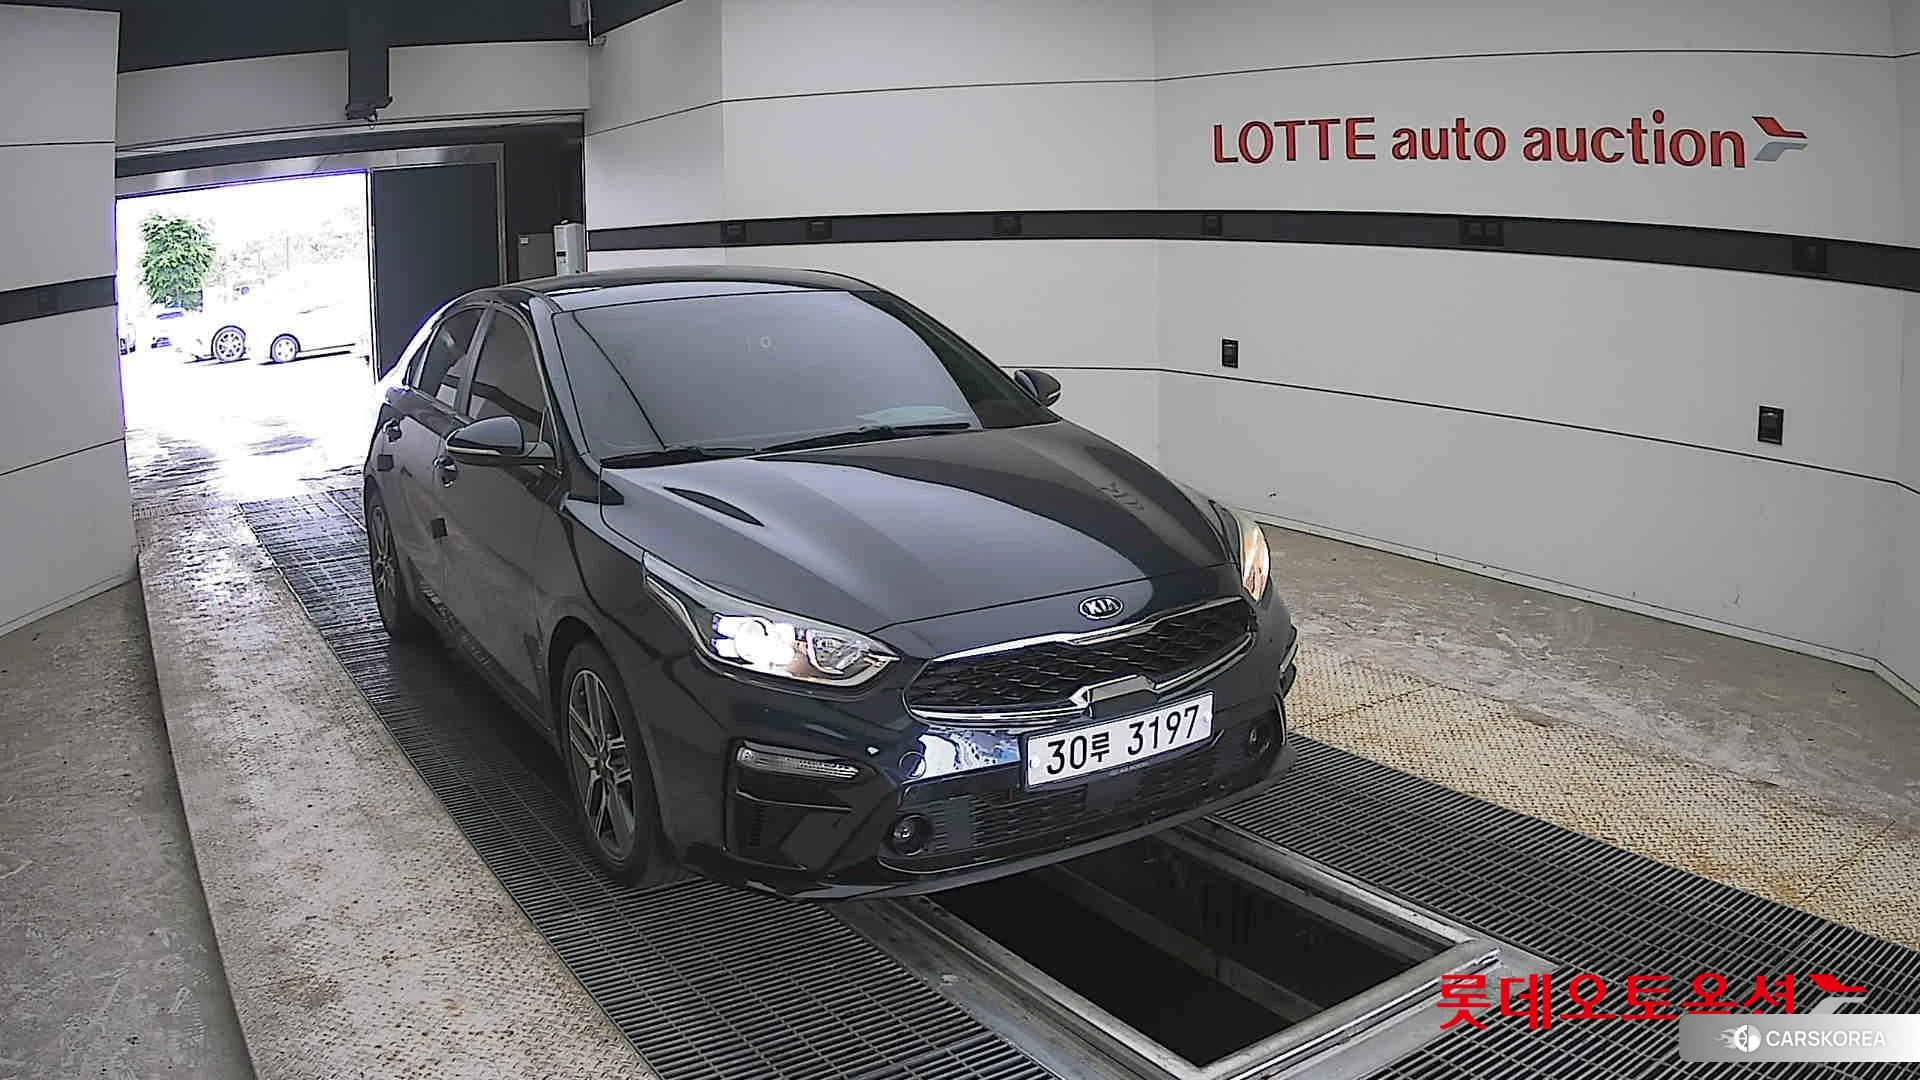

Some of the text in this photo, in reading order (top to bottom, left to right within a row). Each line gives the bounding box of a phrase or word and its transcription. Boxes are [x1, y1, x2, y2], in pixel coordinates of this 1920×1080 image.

[1213, 109, 1747, 169] LOTTE auto auction
[1085, 598, 1120, 615] KIA
[1046, 704, 1200, 775] 30루 3197
